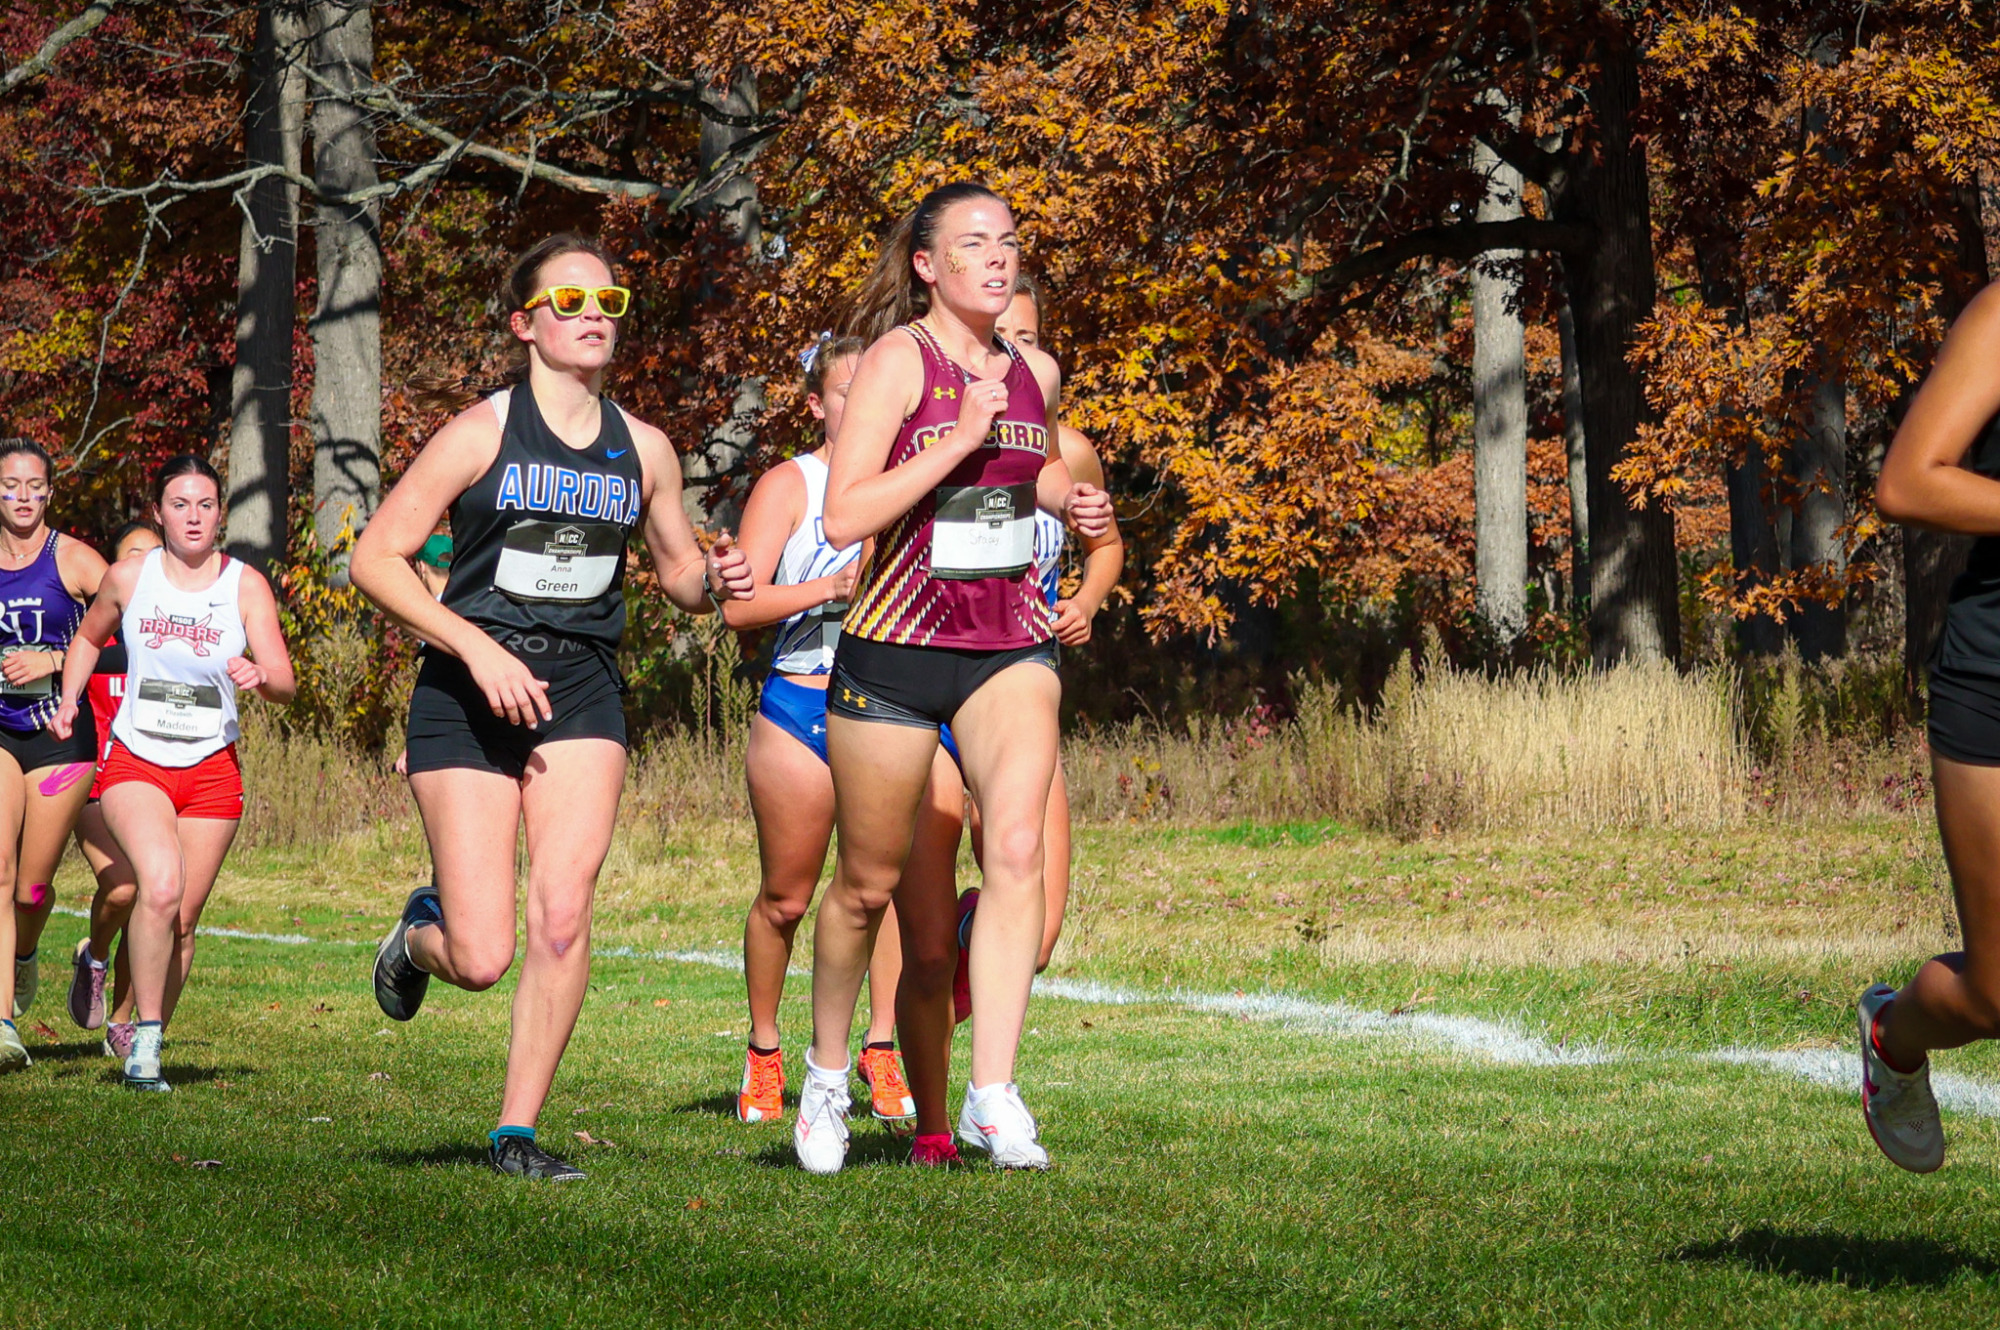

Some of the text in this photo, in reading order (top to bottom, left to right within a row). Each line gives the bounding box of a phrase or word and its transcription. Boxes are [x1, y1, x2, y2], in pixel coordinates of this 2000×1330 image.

[496, 463, 641, 527] AURORA
[551, 565, 572, 573] Anna
[535, 579, 578, 592] Green
[139, 618, 222, 646] RAIDERS
[156, 719, 198, 732] Madden
